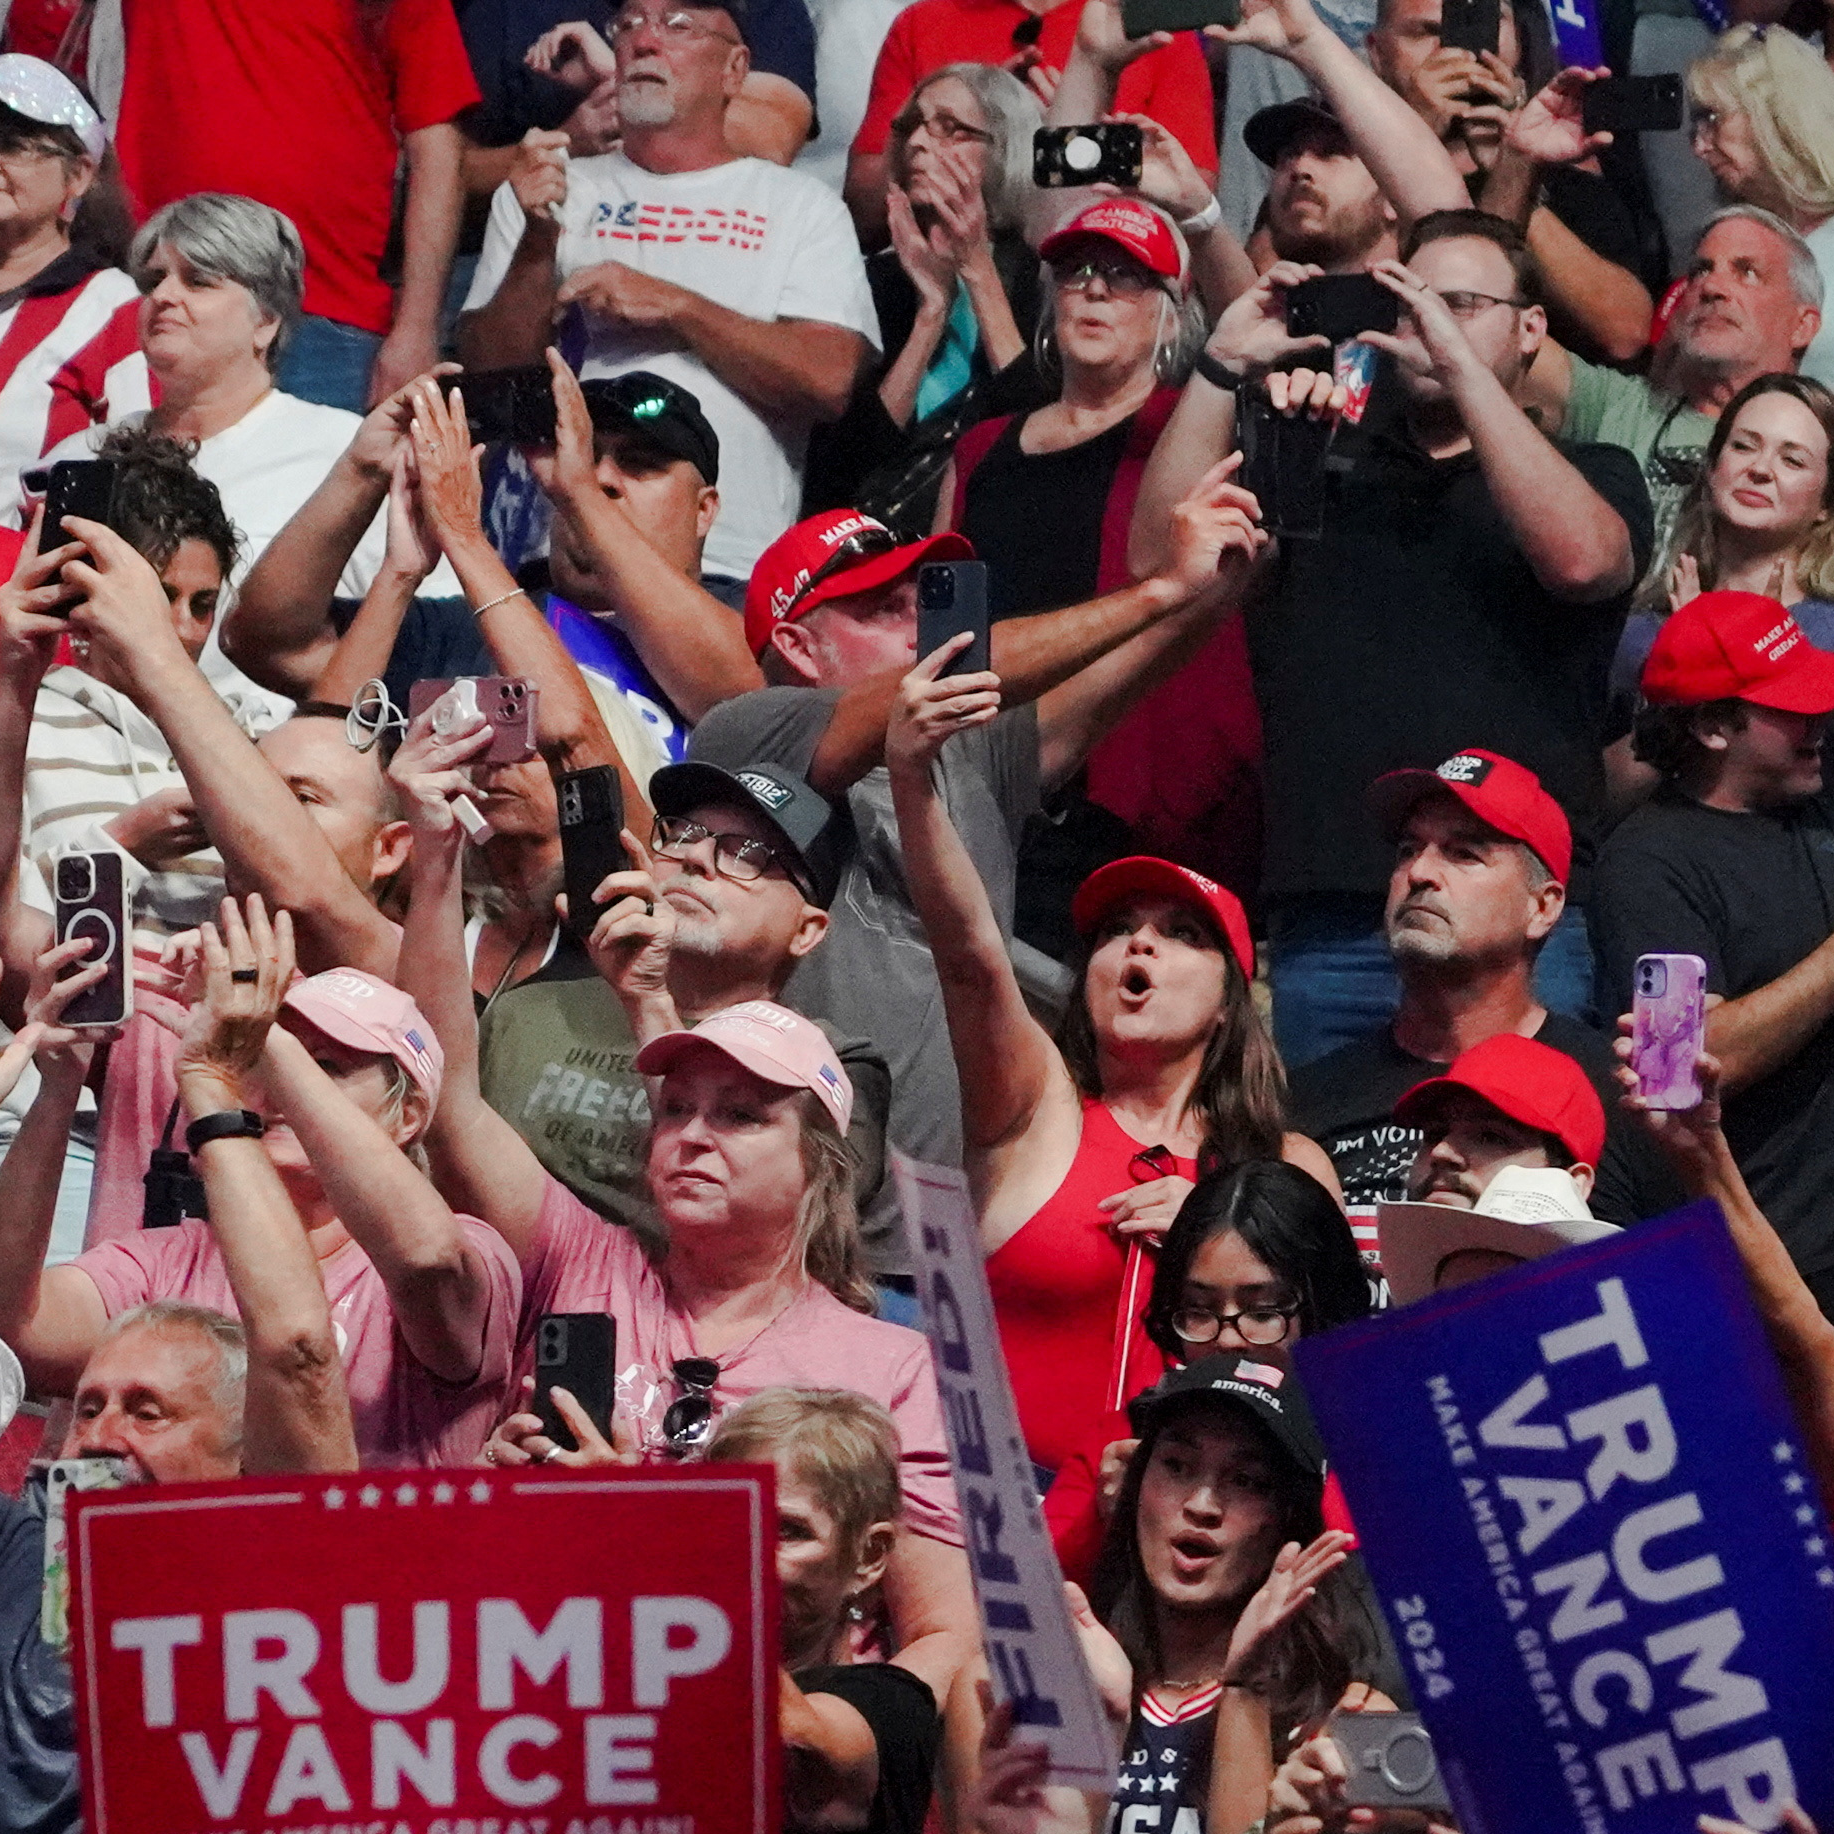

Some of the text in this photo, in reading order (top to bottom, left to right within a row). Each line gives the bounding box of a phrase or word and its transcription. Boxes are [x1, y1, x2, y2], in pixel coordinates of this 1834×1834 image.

[818, 517, 862, 546] MAKE
[1753, 625, 1783, 653] MAKE
[566, 1047, 635, 1074] UNITE
[1210, 1379, 1284, 1414] america.
[1423, 1372, 1474, 1470] MAKE
[1464, 1474, 1528, 1622] AMERICA
[1517, 1626, 1570, 1740] GREAT
[1479, 1373, 1687, 1811] VANCE
[1539, 1276, 1797, 1832] TRUMP
[110, 1596, 734, 1728] TRUMP
[1394, 1593, 1453, 1701] 2024
[179, 1712, 659, 1822] VANCE
